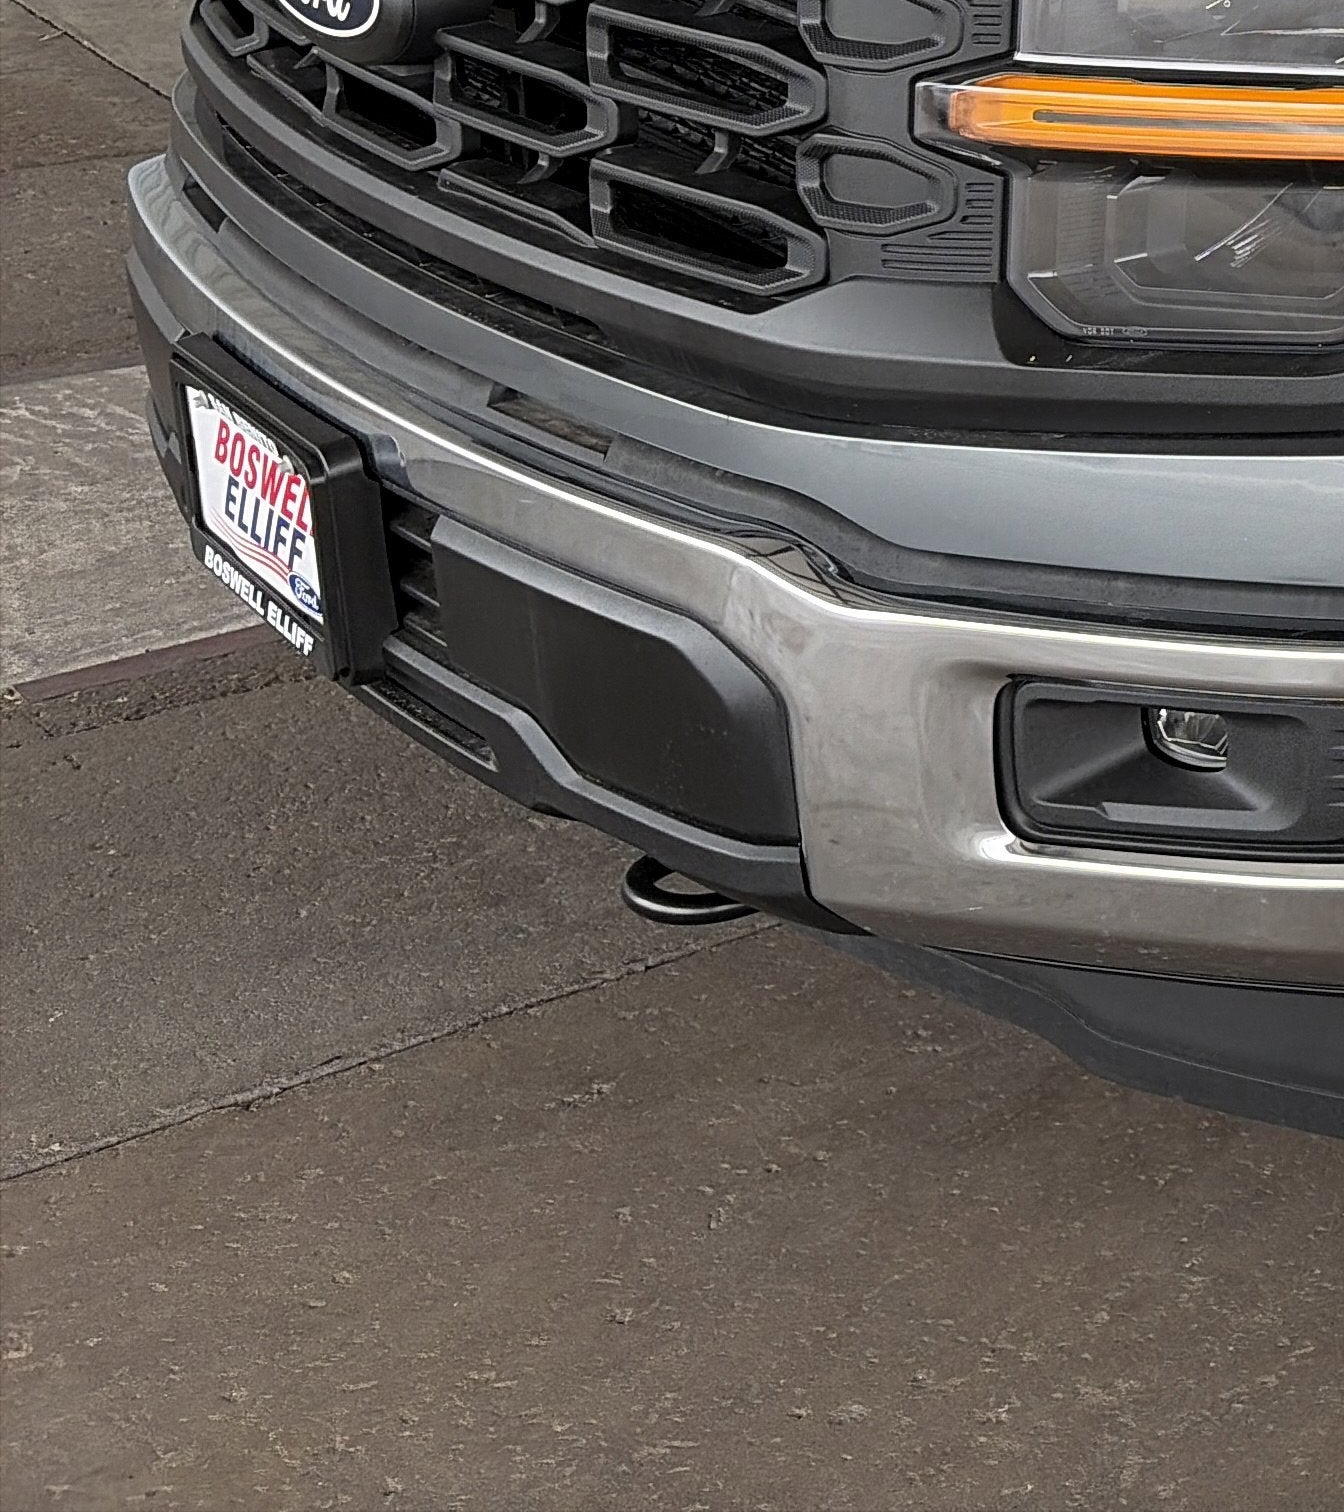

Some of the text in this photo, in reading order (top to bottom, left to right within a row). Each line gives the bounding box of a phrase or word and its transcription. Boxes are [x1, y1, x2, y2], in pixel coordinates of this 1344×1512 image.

[214, 418, 315, 534] BOSWEL
[224, 475, 306, 572] ELLIFF
[204, 544, 315, 656] BOSWELL ELLIFF
[294, 577, 320, 611] Ford
